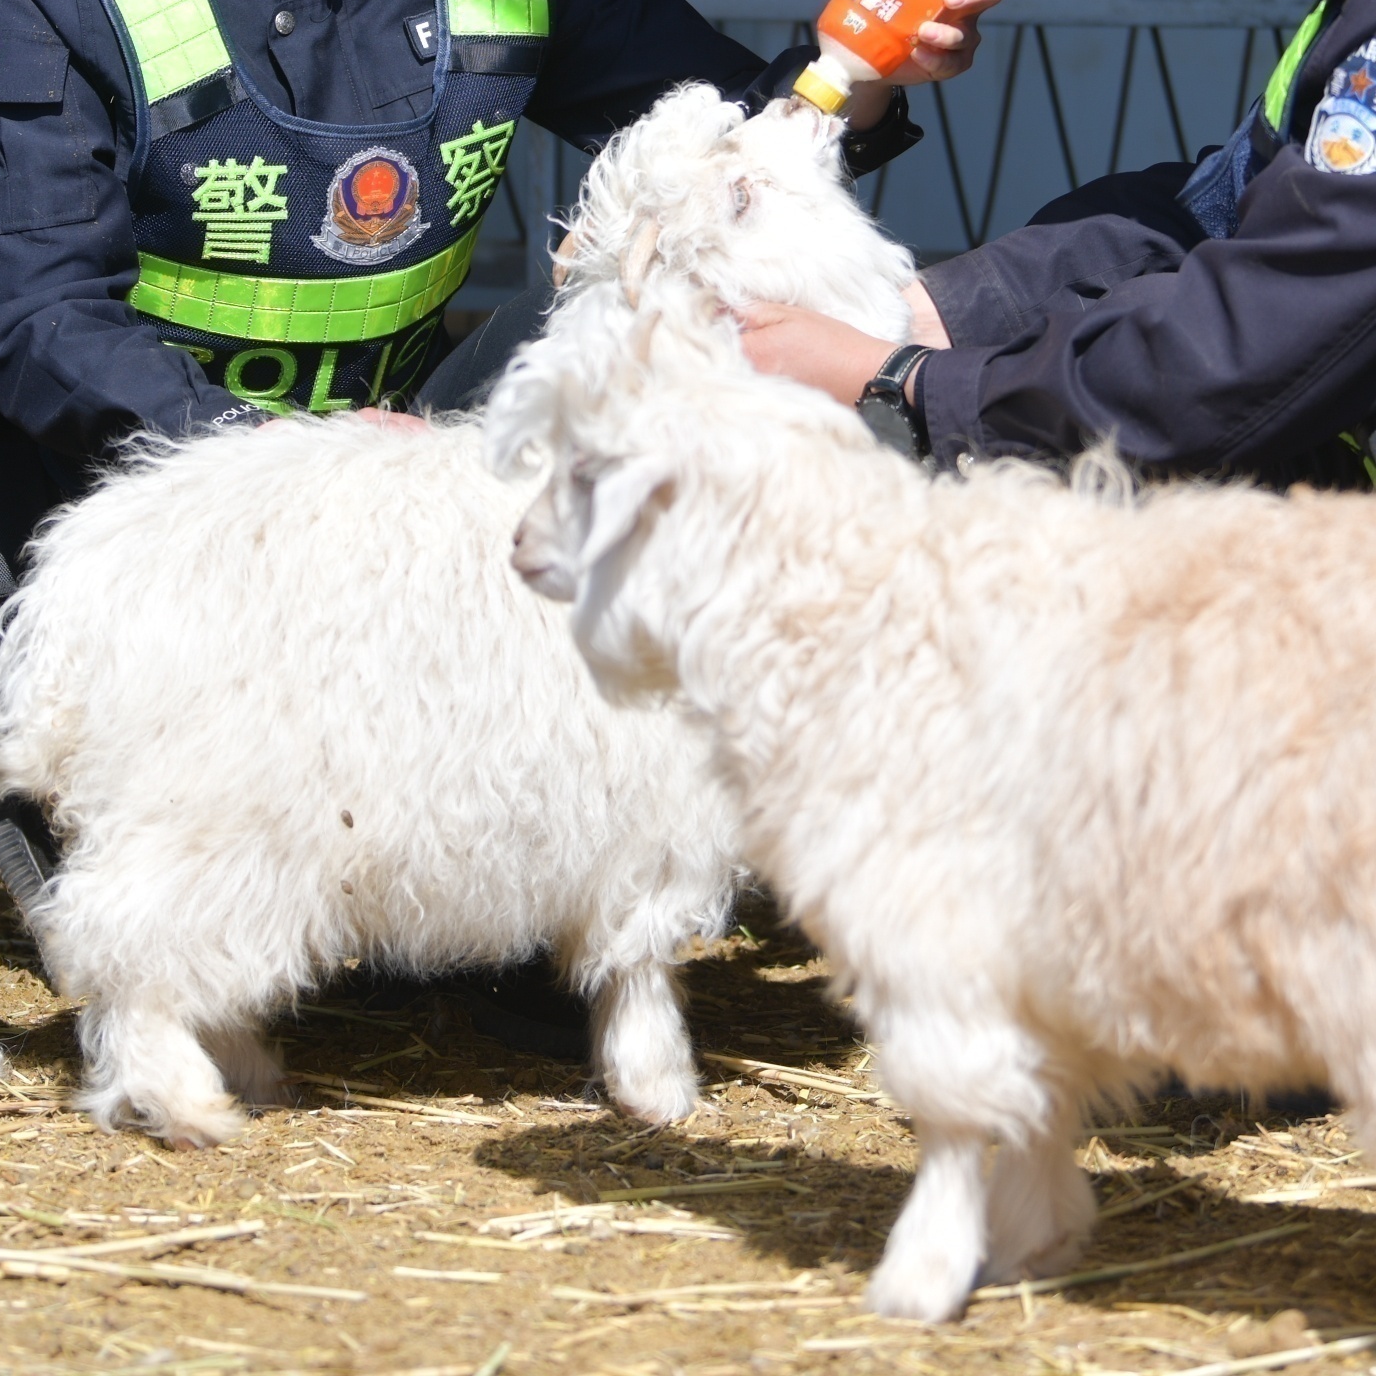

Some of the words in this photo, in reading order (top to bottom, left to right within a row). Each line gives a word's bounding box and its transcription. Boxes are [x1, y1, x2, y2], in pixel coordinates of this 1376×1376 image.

[415, 21, 432, 49] F
[191, 155, 288, 264] 警
[440, 120, 515, 227] 察
[352, 245, 397, 259] POLICE
